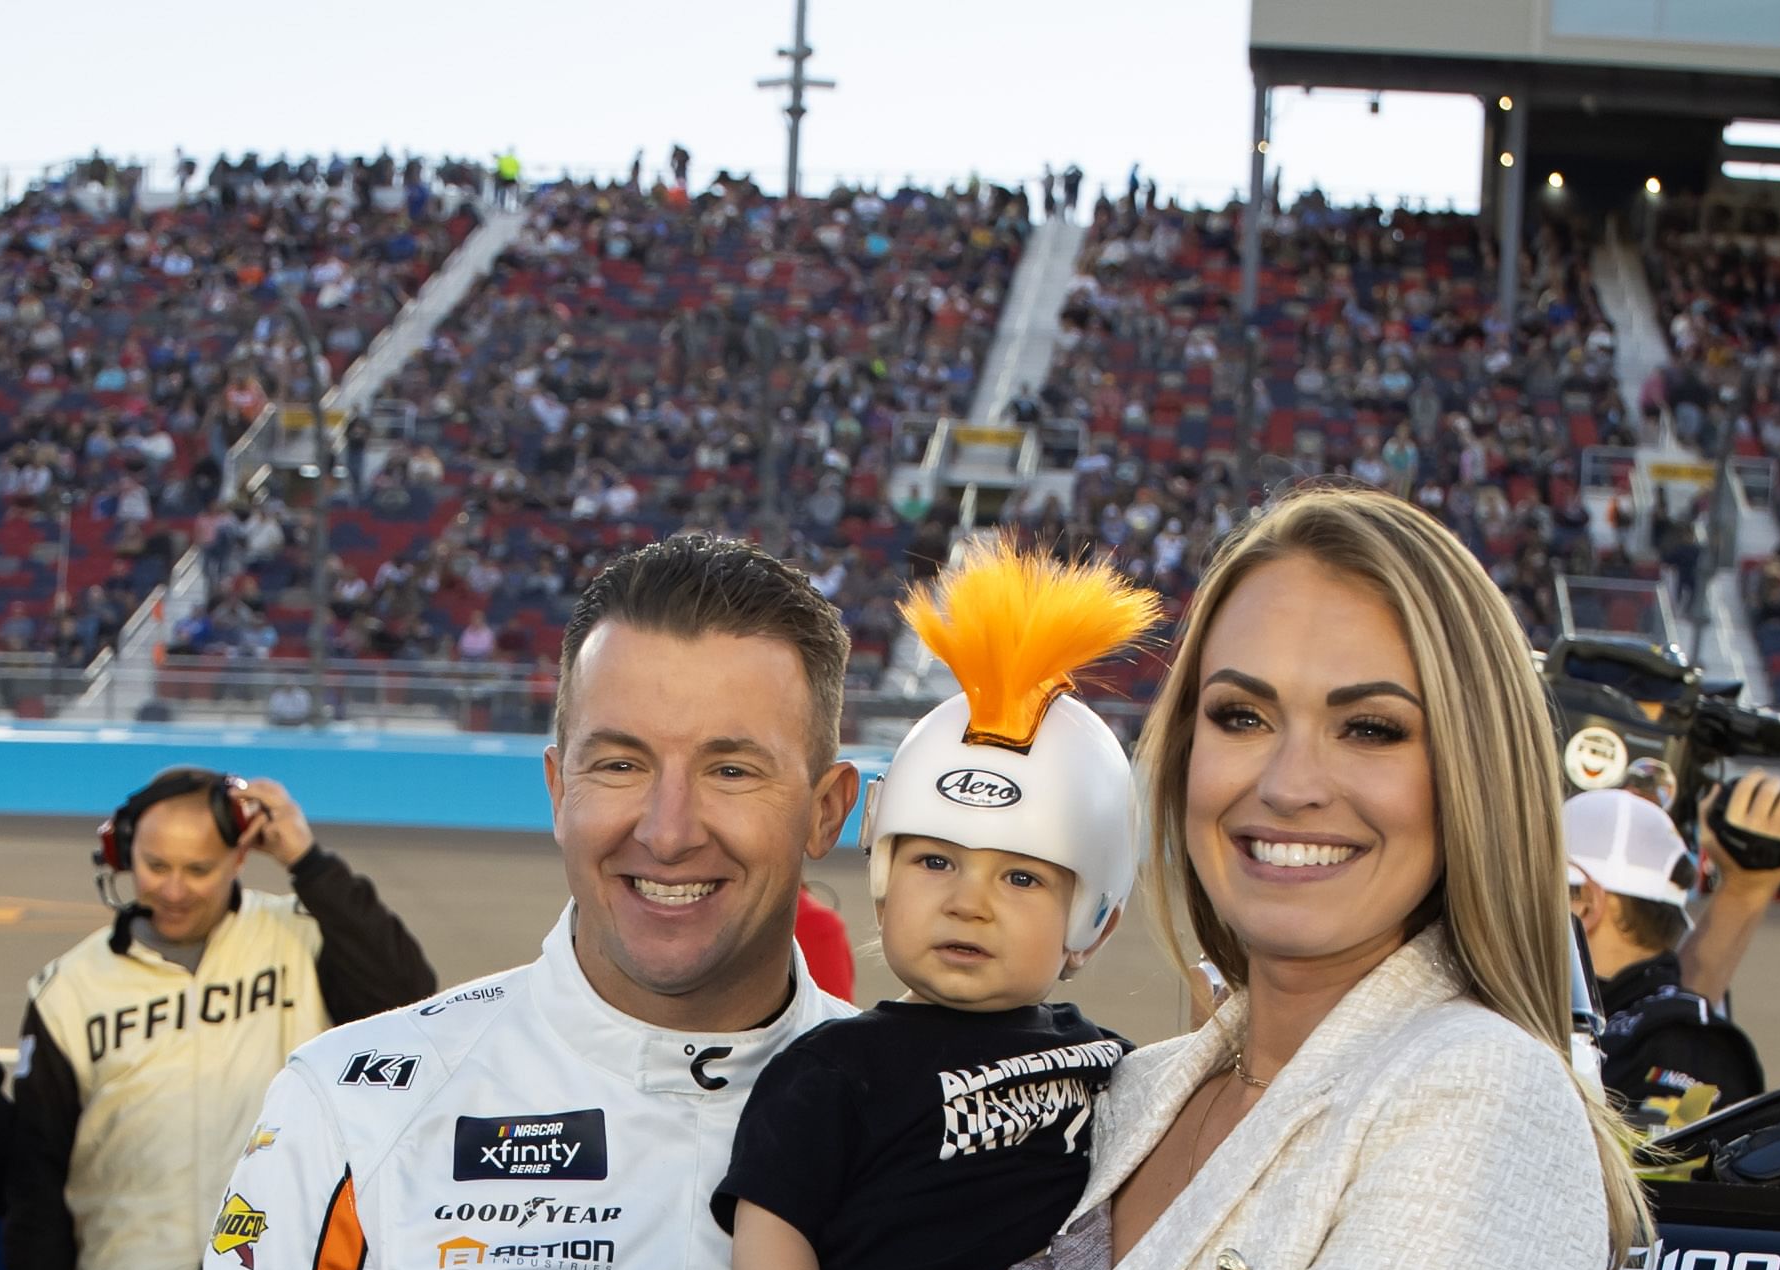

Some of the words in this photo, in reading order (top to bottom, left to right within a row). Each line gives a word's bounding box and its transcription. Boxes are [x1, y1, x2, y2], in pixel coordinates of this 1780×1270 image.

[87, 965, 294, 1062] OFFICIAL
[338, 1048, 421, 1091] K1
[938, 1040, 1122, 1103] ALLMENDING
[514, 1122, 563, 1137] NASCAR
[480, 1139, 581, 1169] xfinity
[509, 1164, 551, 1174] SERIES
[490, 1239, 615, 1263] ACTION
